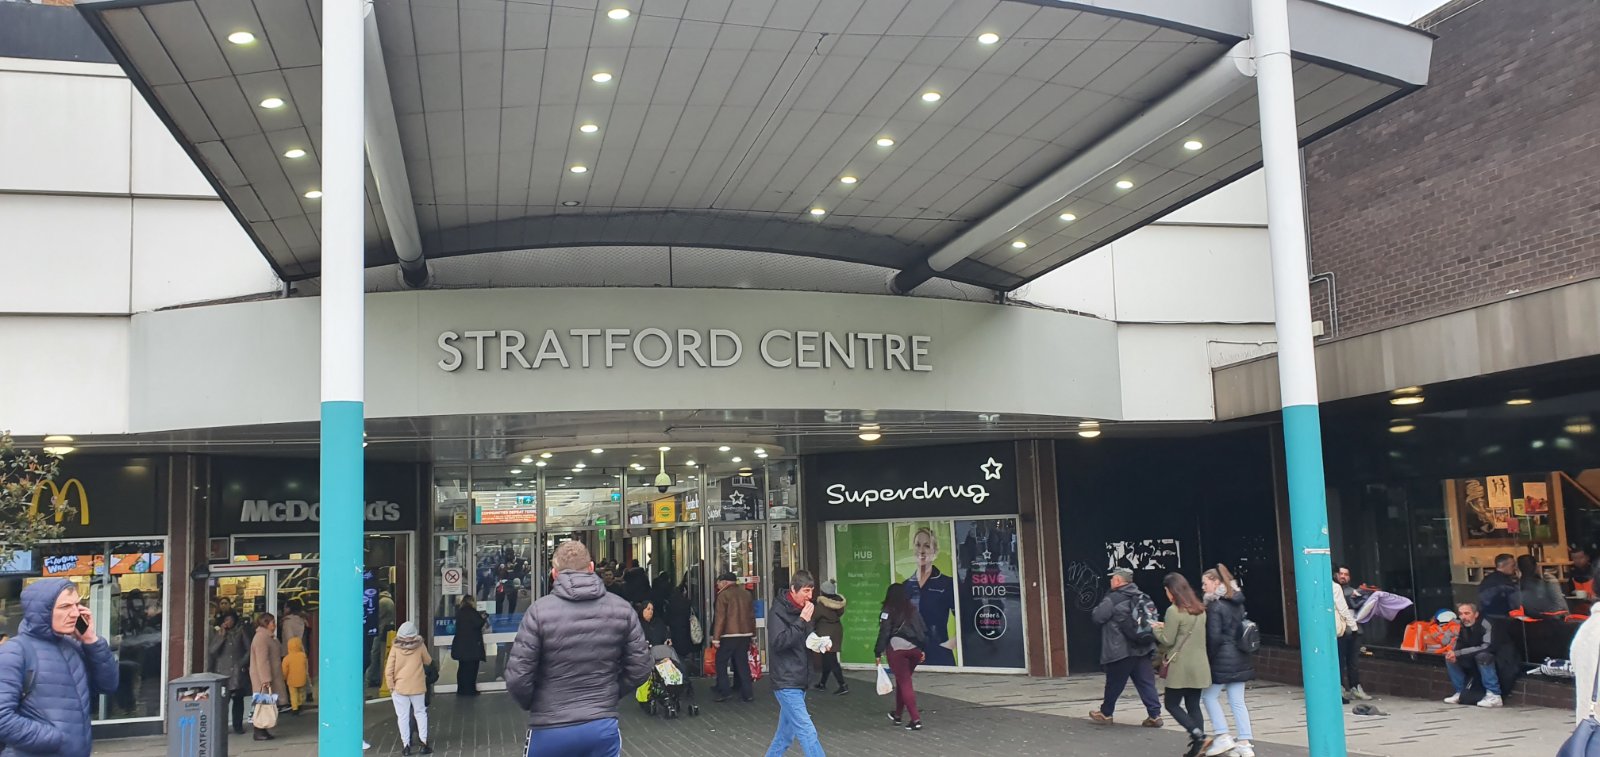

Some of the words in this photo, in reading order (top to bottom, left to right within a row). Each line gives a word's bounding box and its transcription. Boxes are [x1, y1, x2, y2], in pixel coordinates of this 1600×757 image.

[437, 327, 742, 372] STRATFORD
[760, 329, 933, 372] CENTRE
[826, 481, 990, 507] Superdrug
[853, 551, 873, 560] HUB
[972, 573, 1006, 584] save
[972, 585, 1007, 597] more
